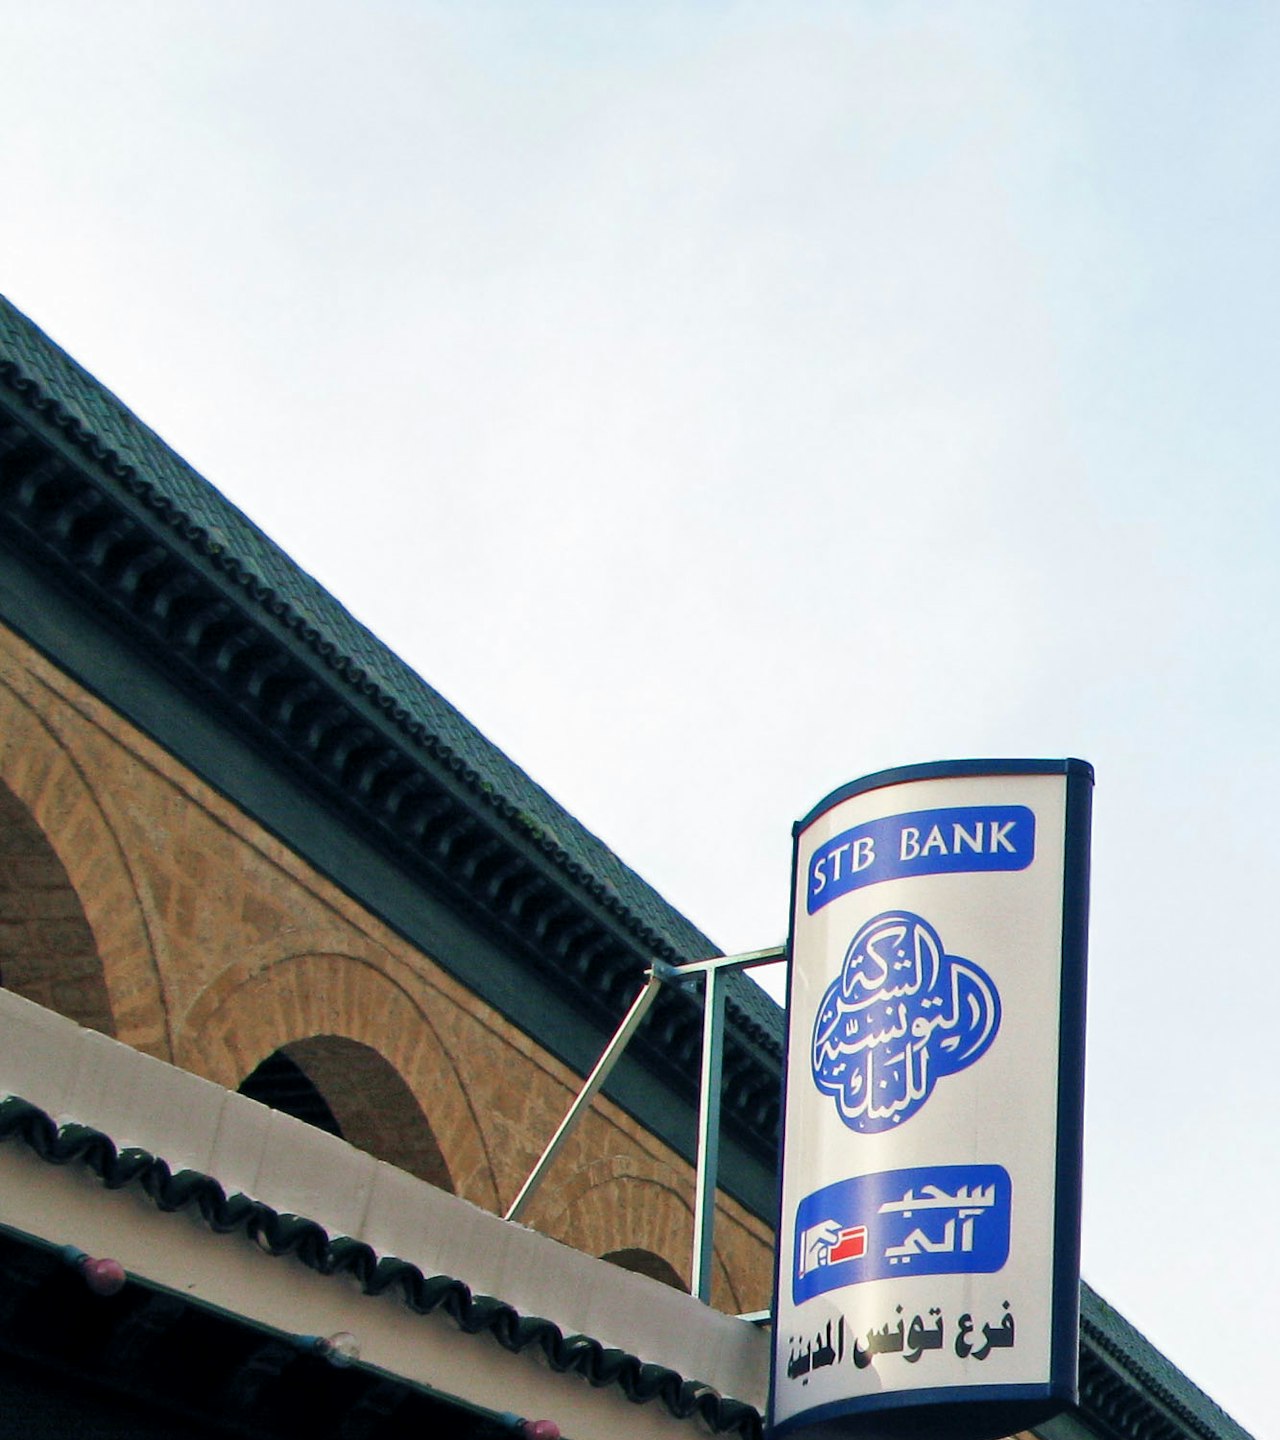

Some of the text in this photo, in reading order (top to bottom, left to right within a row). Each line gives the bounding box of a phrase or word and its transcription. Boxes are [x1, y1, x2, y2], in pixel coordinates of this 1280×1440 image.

[813, 821, 1018, 895] STB BANK
[877, 1183, 996, 1219] سحب
[786, 1300, 1016, 1386] فرع تونس المدينة
